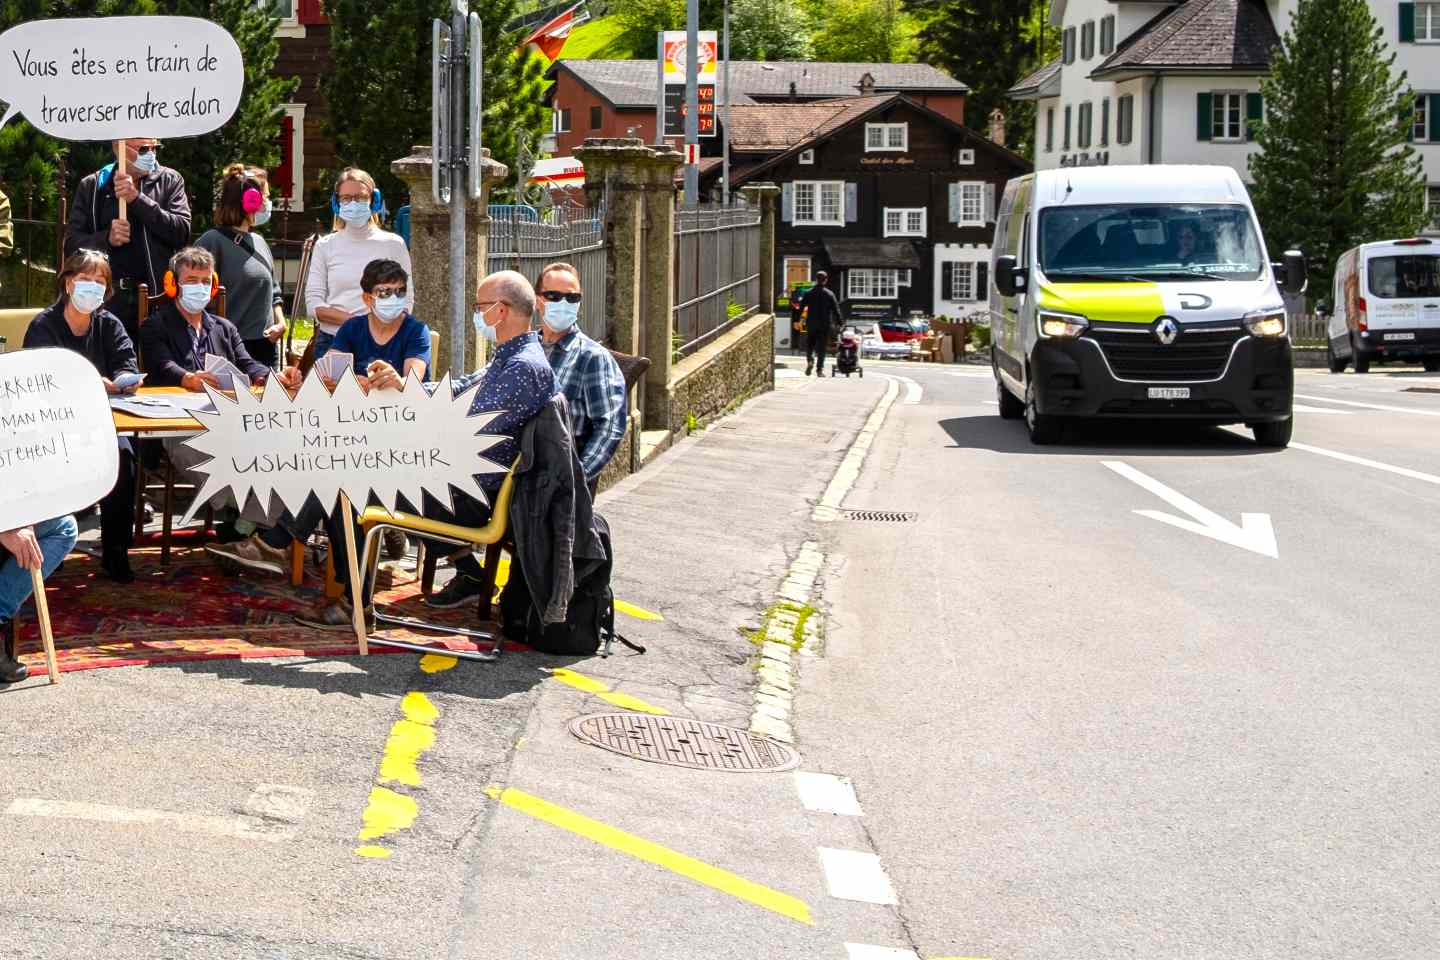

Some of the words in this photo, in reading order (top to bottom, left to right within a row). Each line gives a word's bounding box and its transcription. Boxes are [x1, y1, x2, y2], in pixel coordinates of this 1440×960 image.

[13, 48, 58, 77] Vous
[71, 47, 107, 76] êtes
[115, 58, 137, 74] en
[147, 44, 190, 73] train
[196, 44, 218, 72] de
[41, 95, 123, 124] traverser
[127, 91, 169, 121] notre
[175, 87, 220, 117] salon
[1, 411, 35, 429] MAN
